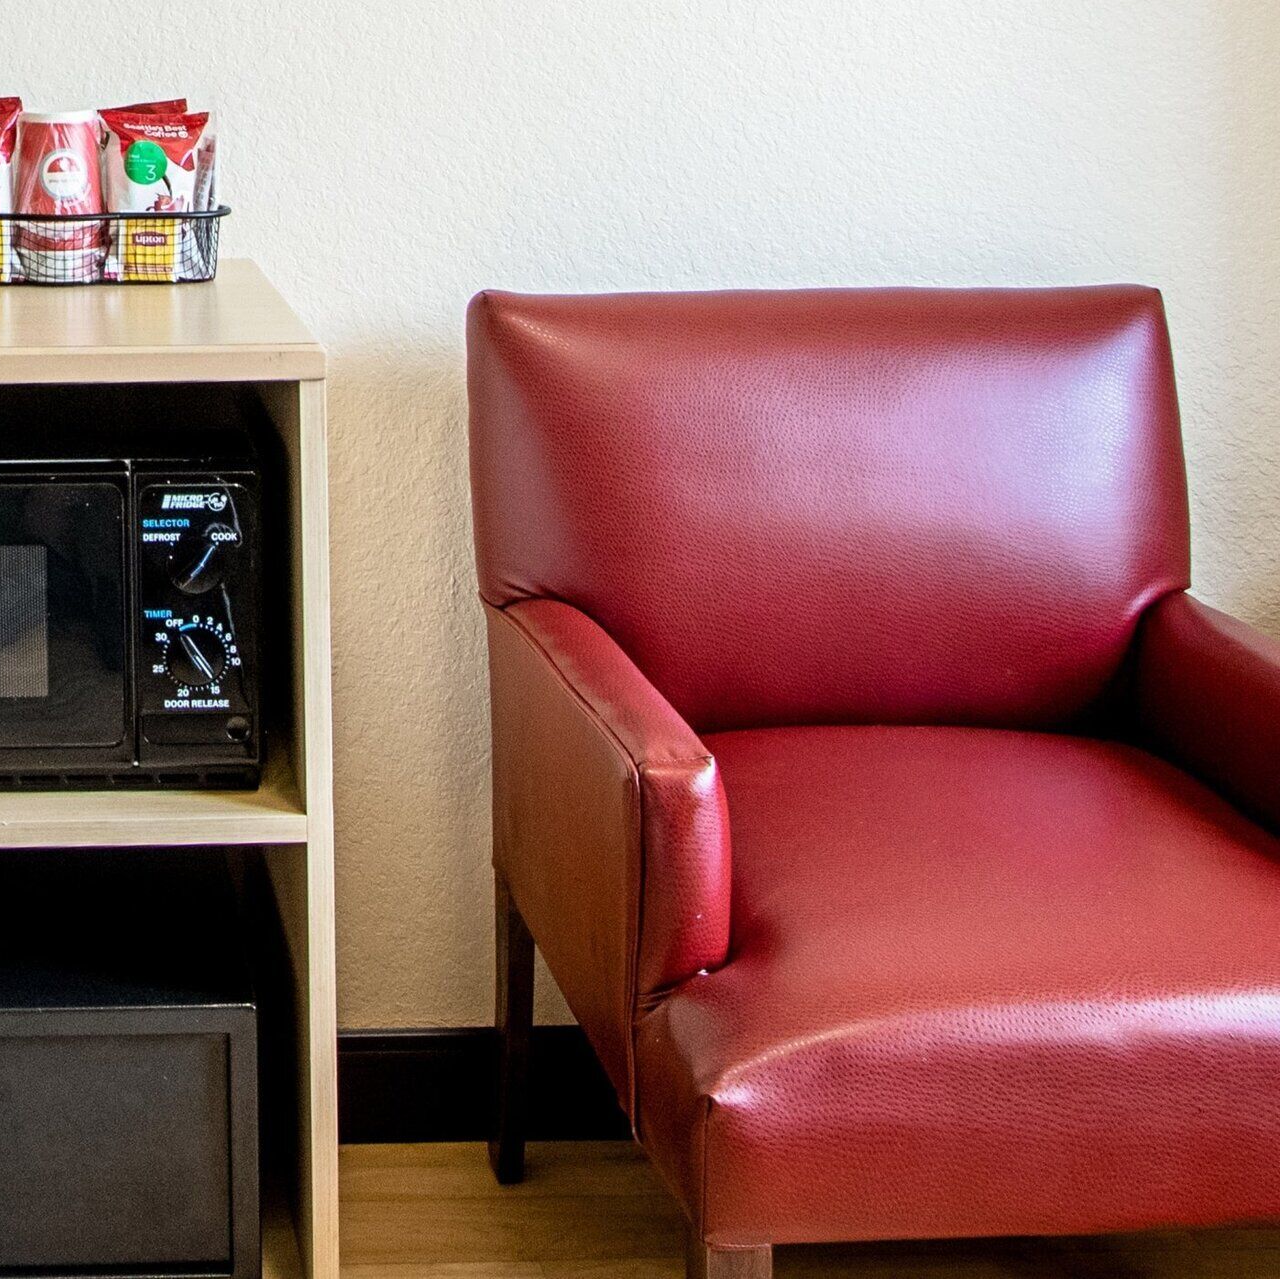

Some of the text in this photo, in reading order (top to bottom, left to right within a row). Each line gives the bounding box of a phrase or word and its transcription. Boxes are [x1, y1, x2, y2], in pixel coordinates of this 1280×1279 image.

[145, 164, 156, 180] 3
[135, 235, 165, 245] Lipton
[171, 494, 204, 502] MICRO
[169, 501, 206, 509] FRIDGE
[142, 519, 191, 528] SELECTOR
[142, 533, 181, 542] DEFROST
[211, 532, 238, 541] COOK
[144, 610, 172, 618] TIMER
[165, 619, 184, 628] OFF
[192, 615, 200, 624] 0
[206, 616, 214, 625] 2
[216, 623, 223, 632] 4
[155, 633, 168, 642] 30
[225, 633, 232, 642] 6
[229, 645, 237, 654] 8
[231, 658, 241, 666] 10
[152, 665, 164, 674] 25
[177, 689, 190, 698] 20
[210, 686, 220, 695] 15
[164, 700, 230, 708] DOOR RELEASE
